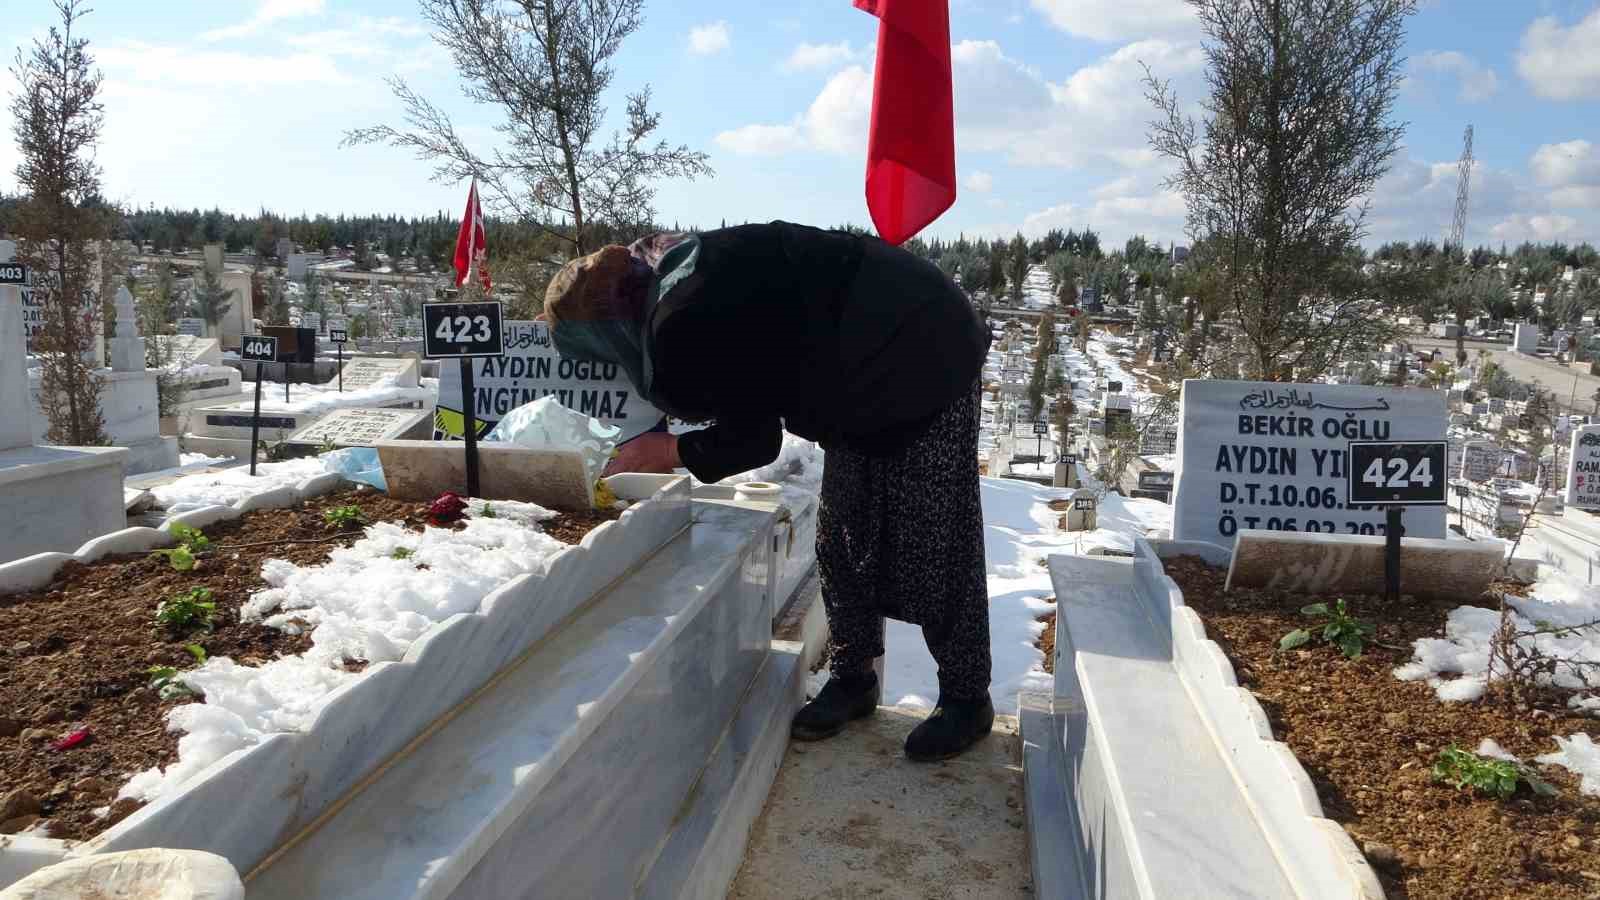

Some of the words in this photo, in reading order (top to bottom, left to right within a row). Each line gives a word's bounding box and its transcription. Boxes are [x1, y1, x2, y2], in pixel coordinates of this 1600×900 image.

[435, 315, 492, 343] 423
[246, 341, 272, 356] 404
[481, 356, 550, 379] AYDIN
[1238, 411, 1314, 437] BEKİR
[1322, 412, 1390, 440] OĞLU
[1215, 445, 1296, 476] AYDIN
[1362, 457, 1433, 489] 424
[1576, 460, 1600, 473] RAM
